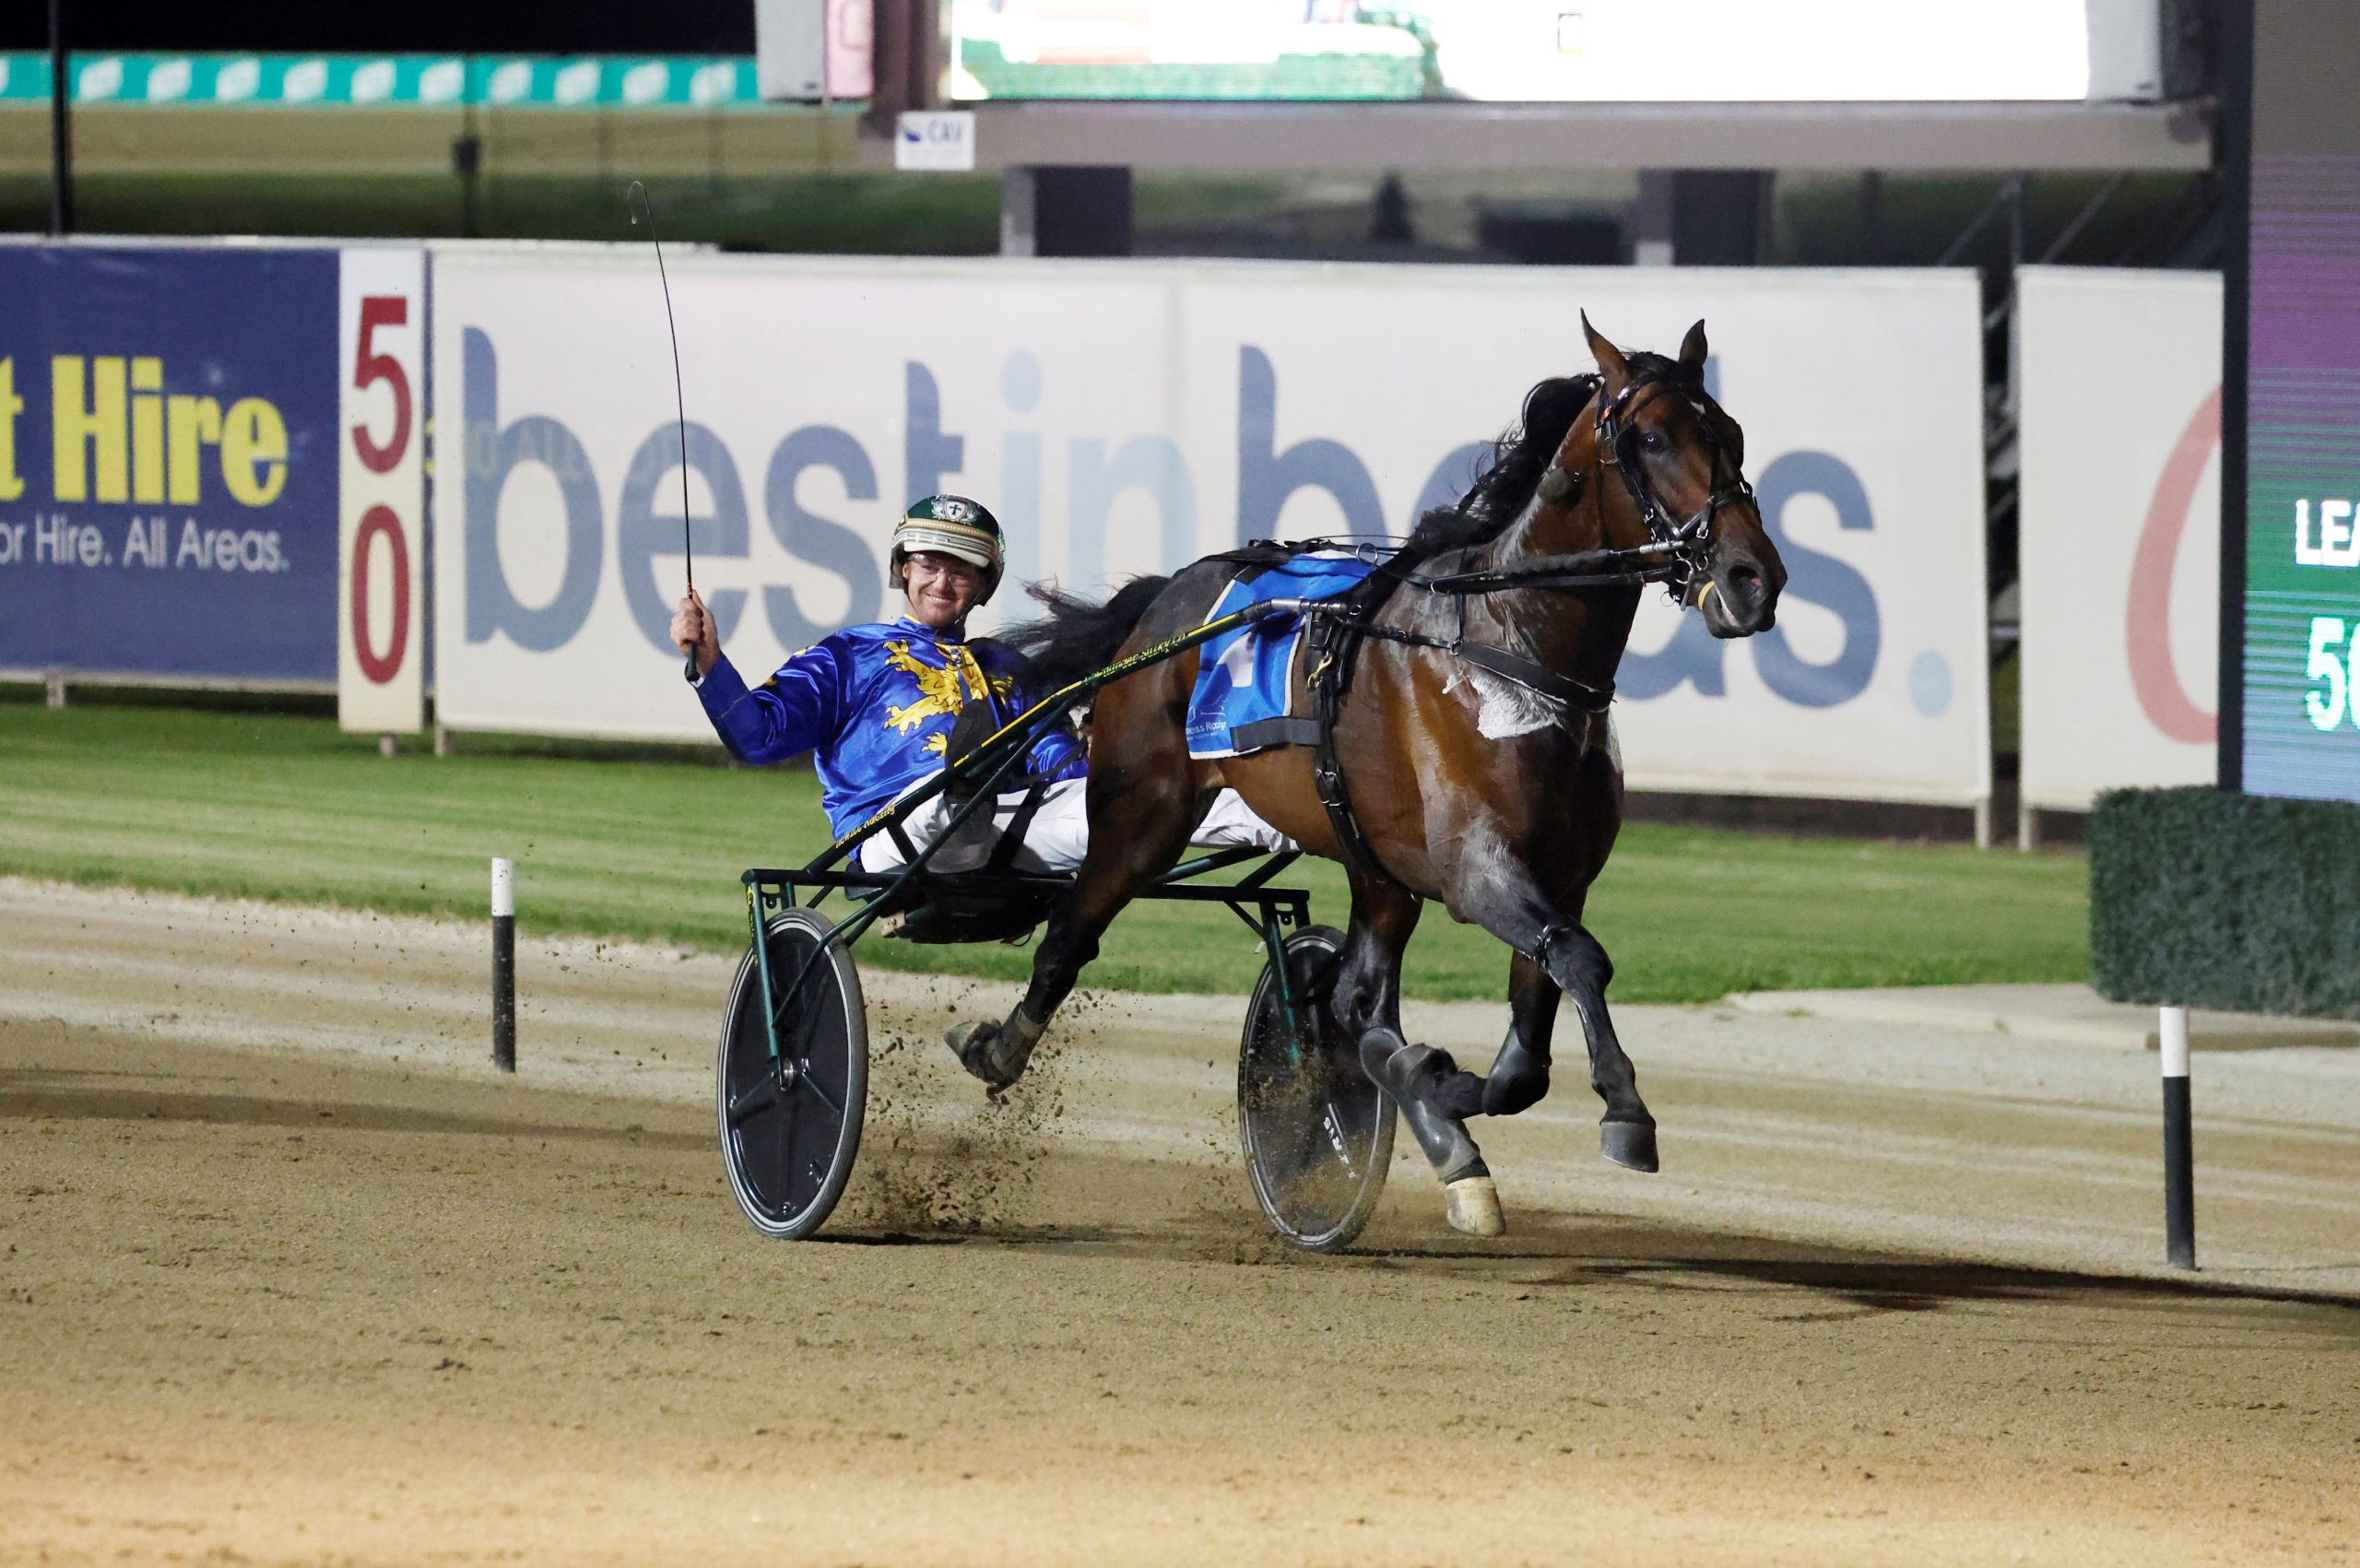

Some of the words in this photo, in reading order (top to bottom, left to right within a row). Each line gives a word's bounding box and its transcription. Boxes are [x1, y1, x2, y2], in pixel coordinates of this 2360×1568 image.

[52, 355, 289, 506] Hire
[35, 513, 112, 568] Hire.
[122, 516, 167, 568] All
[174, 517, 290, 572] Areas.
